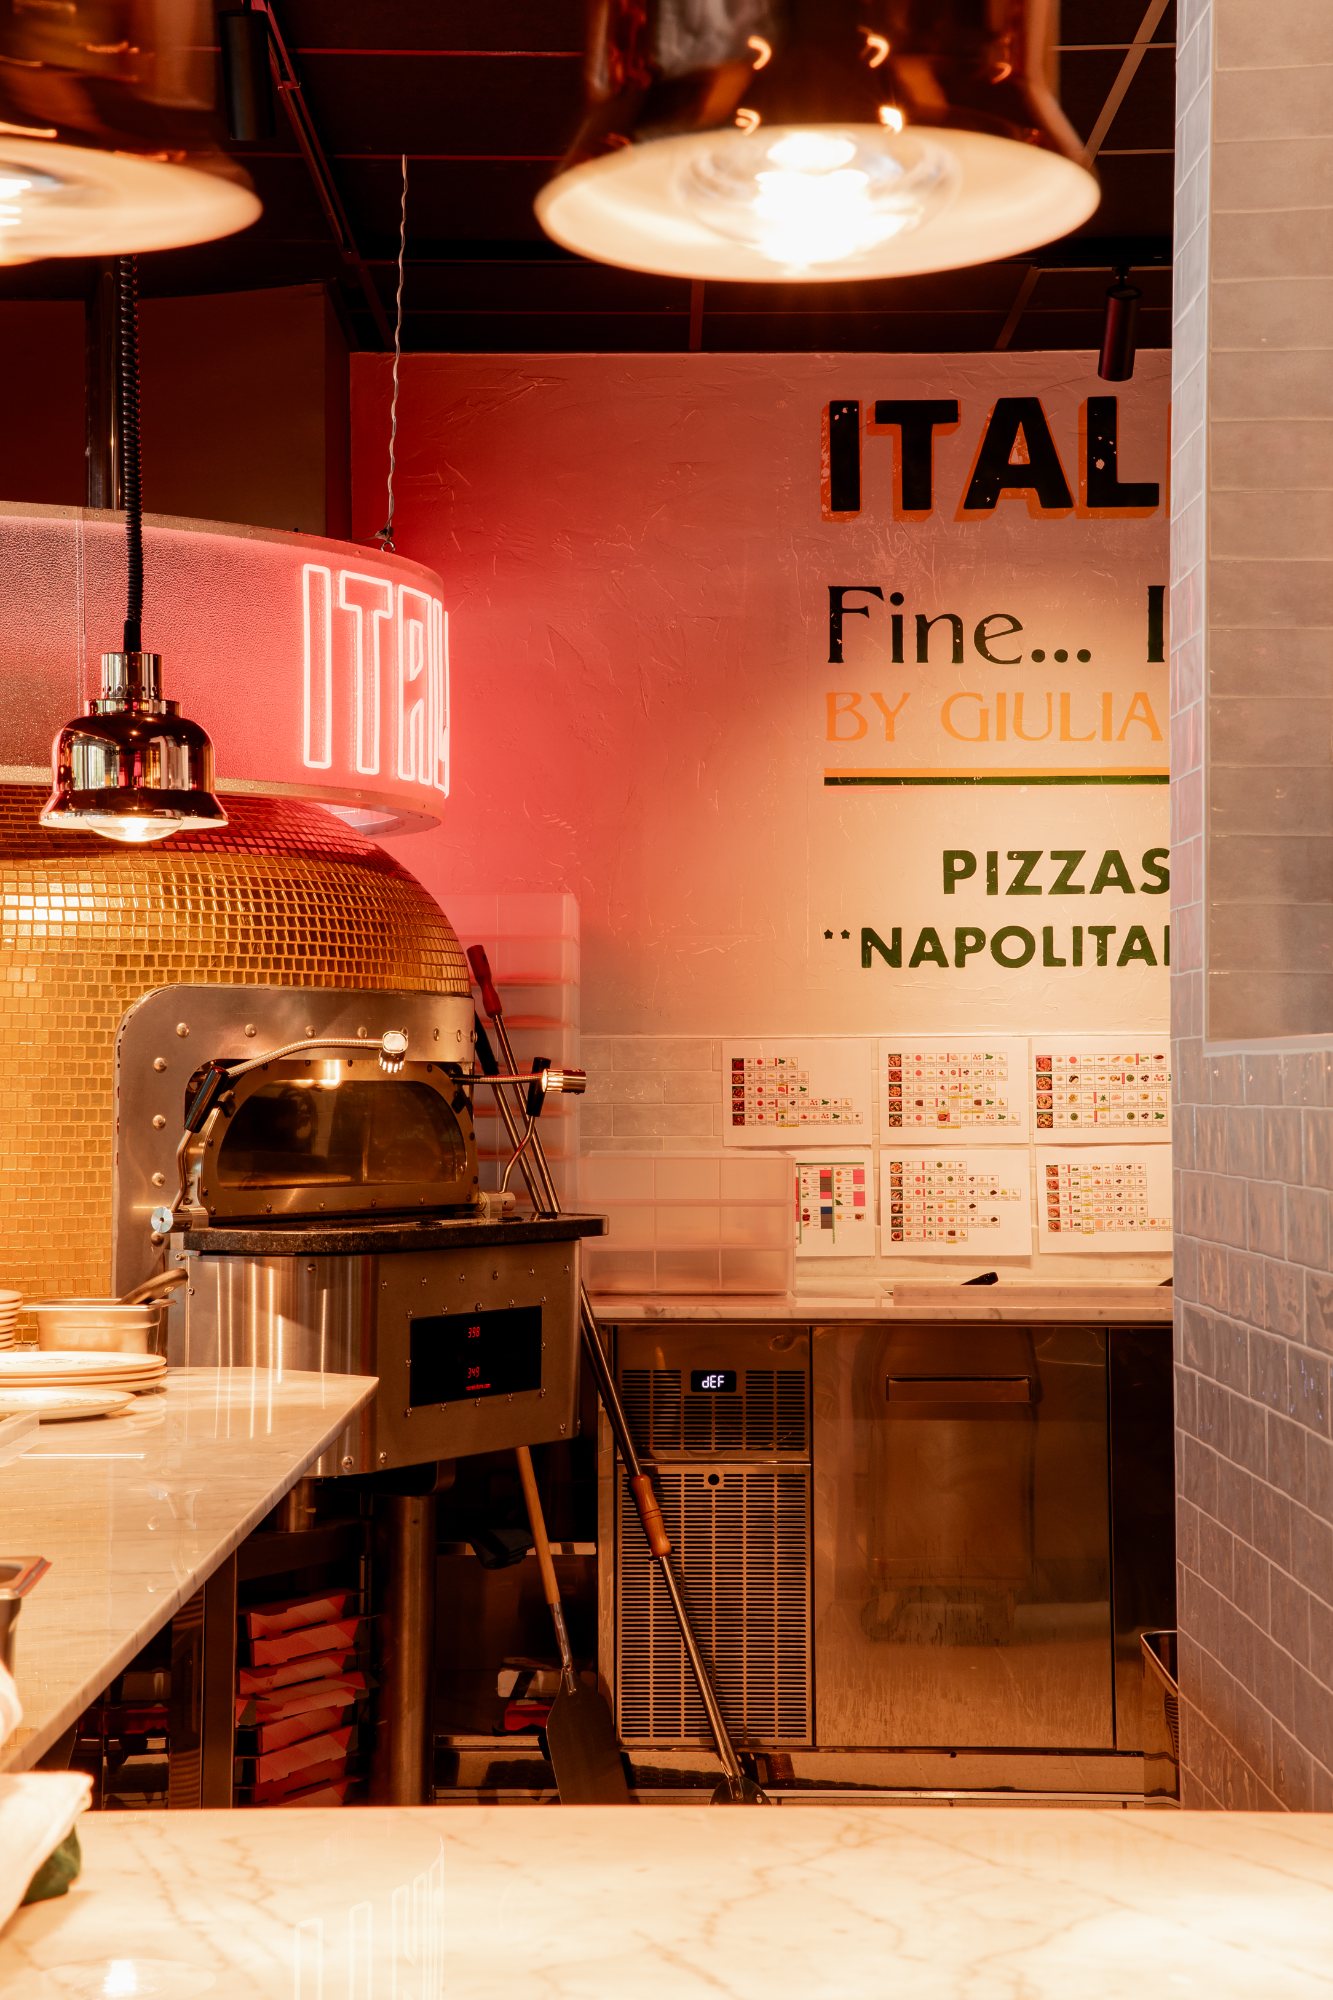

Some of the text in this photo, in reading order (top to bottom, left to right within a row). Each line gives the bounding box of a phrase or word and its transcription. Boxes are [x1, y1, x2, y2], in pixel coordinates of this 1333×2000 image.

[827, 584, 1092, 665] Fine...
[825, 691, 1164, 742] BY GIULIA
[942, 848, 1170, 896] PIZZAS
[701, 1374, 725, 1389] dEF
